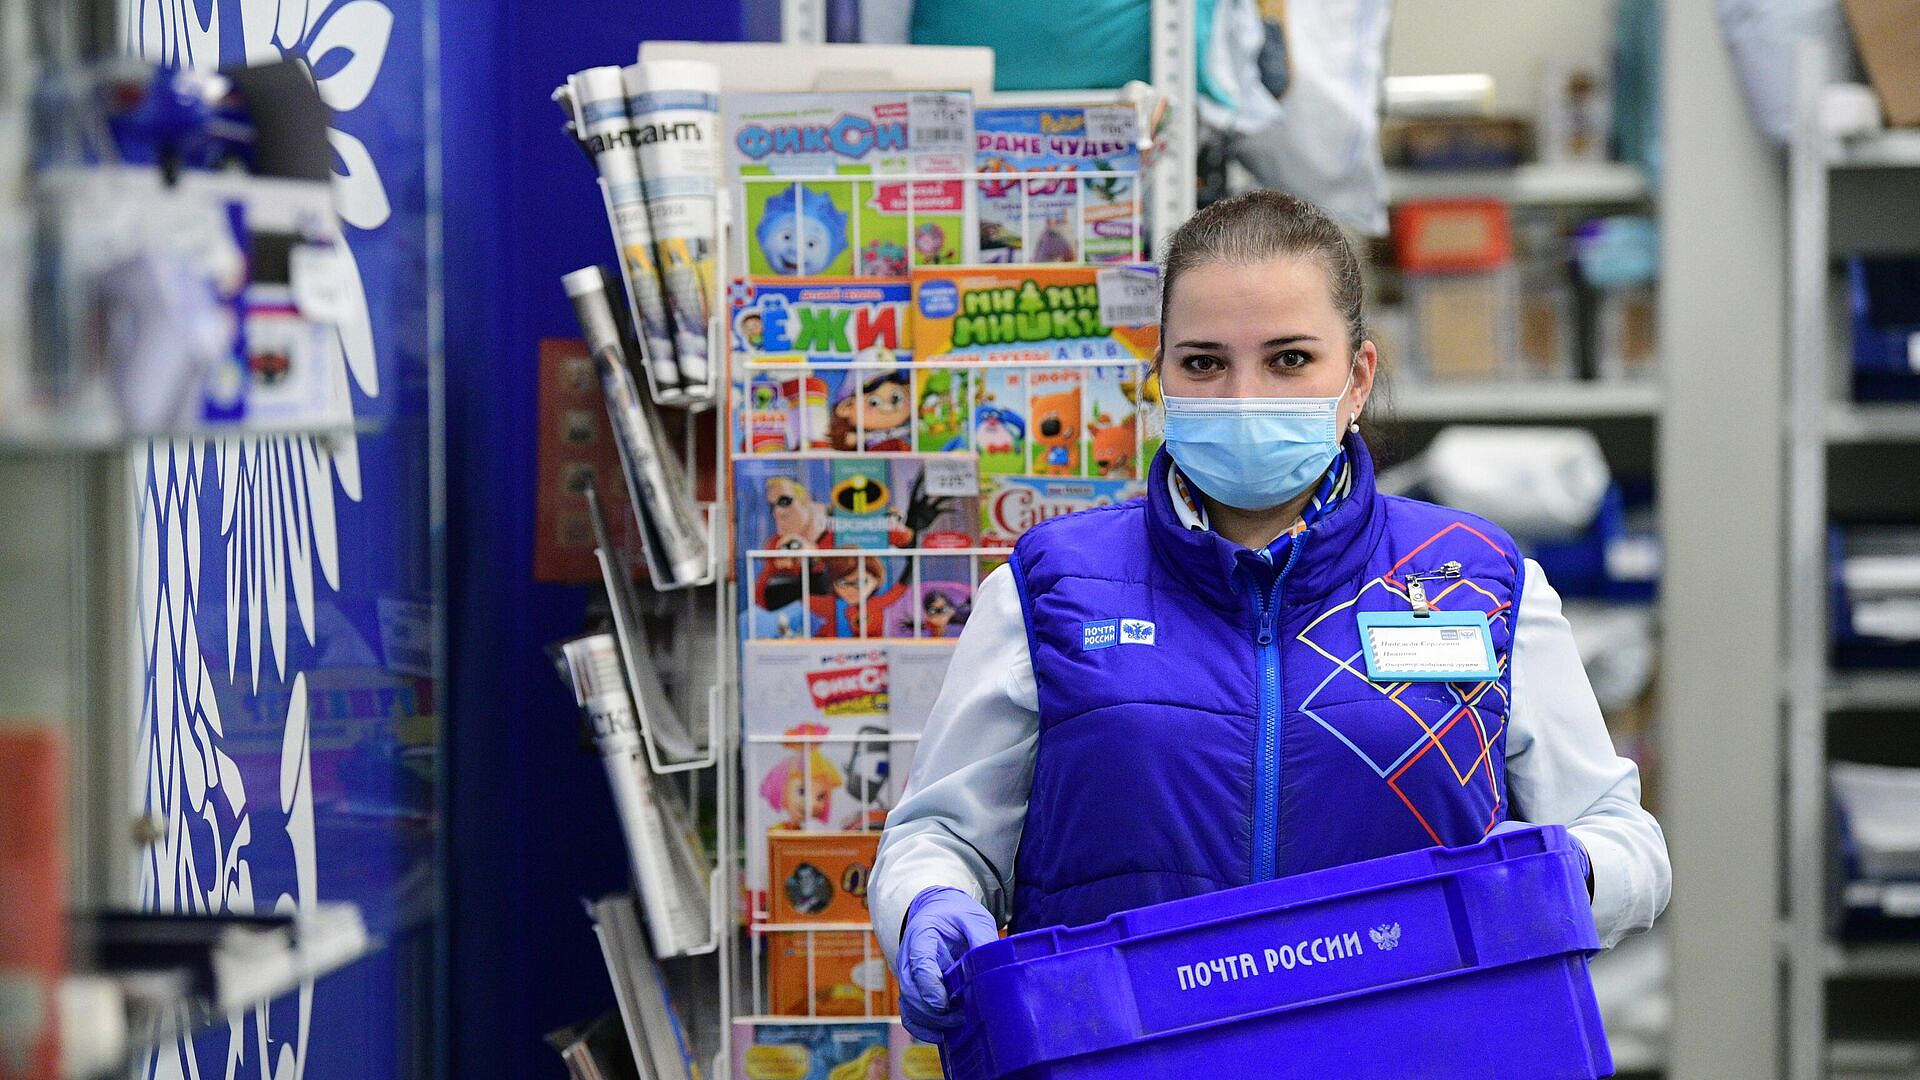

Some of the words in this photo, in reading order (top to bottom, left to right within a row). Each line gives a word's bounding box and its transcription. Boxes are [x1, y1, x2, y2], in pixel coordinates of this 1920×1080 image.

[736, 113, 907, 160] ФИКСИ
[762, 299, 912, 352] ЁЖИ
[1084, 625, 1115, 637] ПОЧТА
[1084, 633, 1115, 645] РОССИИ
[1176, 952, 1259, 991] ПОЧТА
[1263, 930, 1363, 973] РОССИИ
